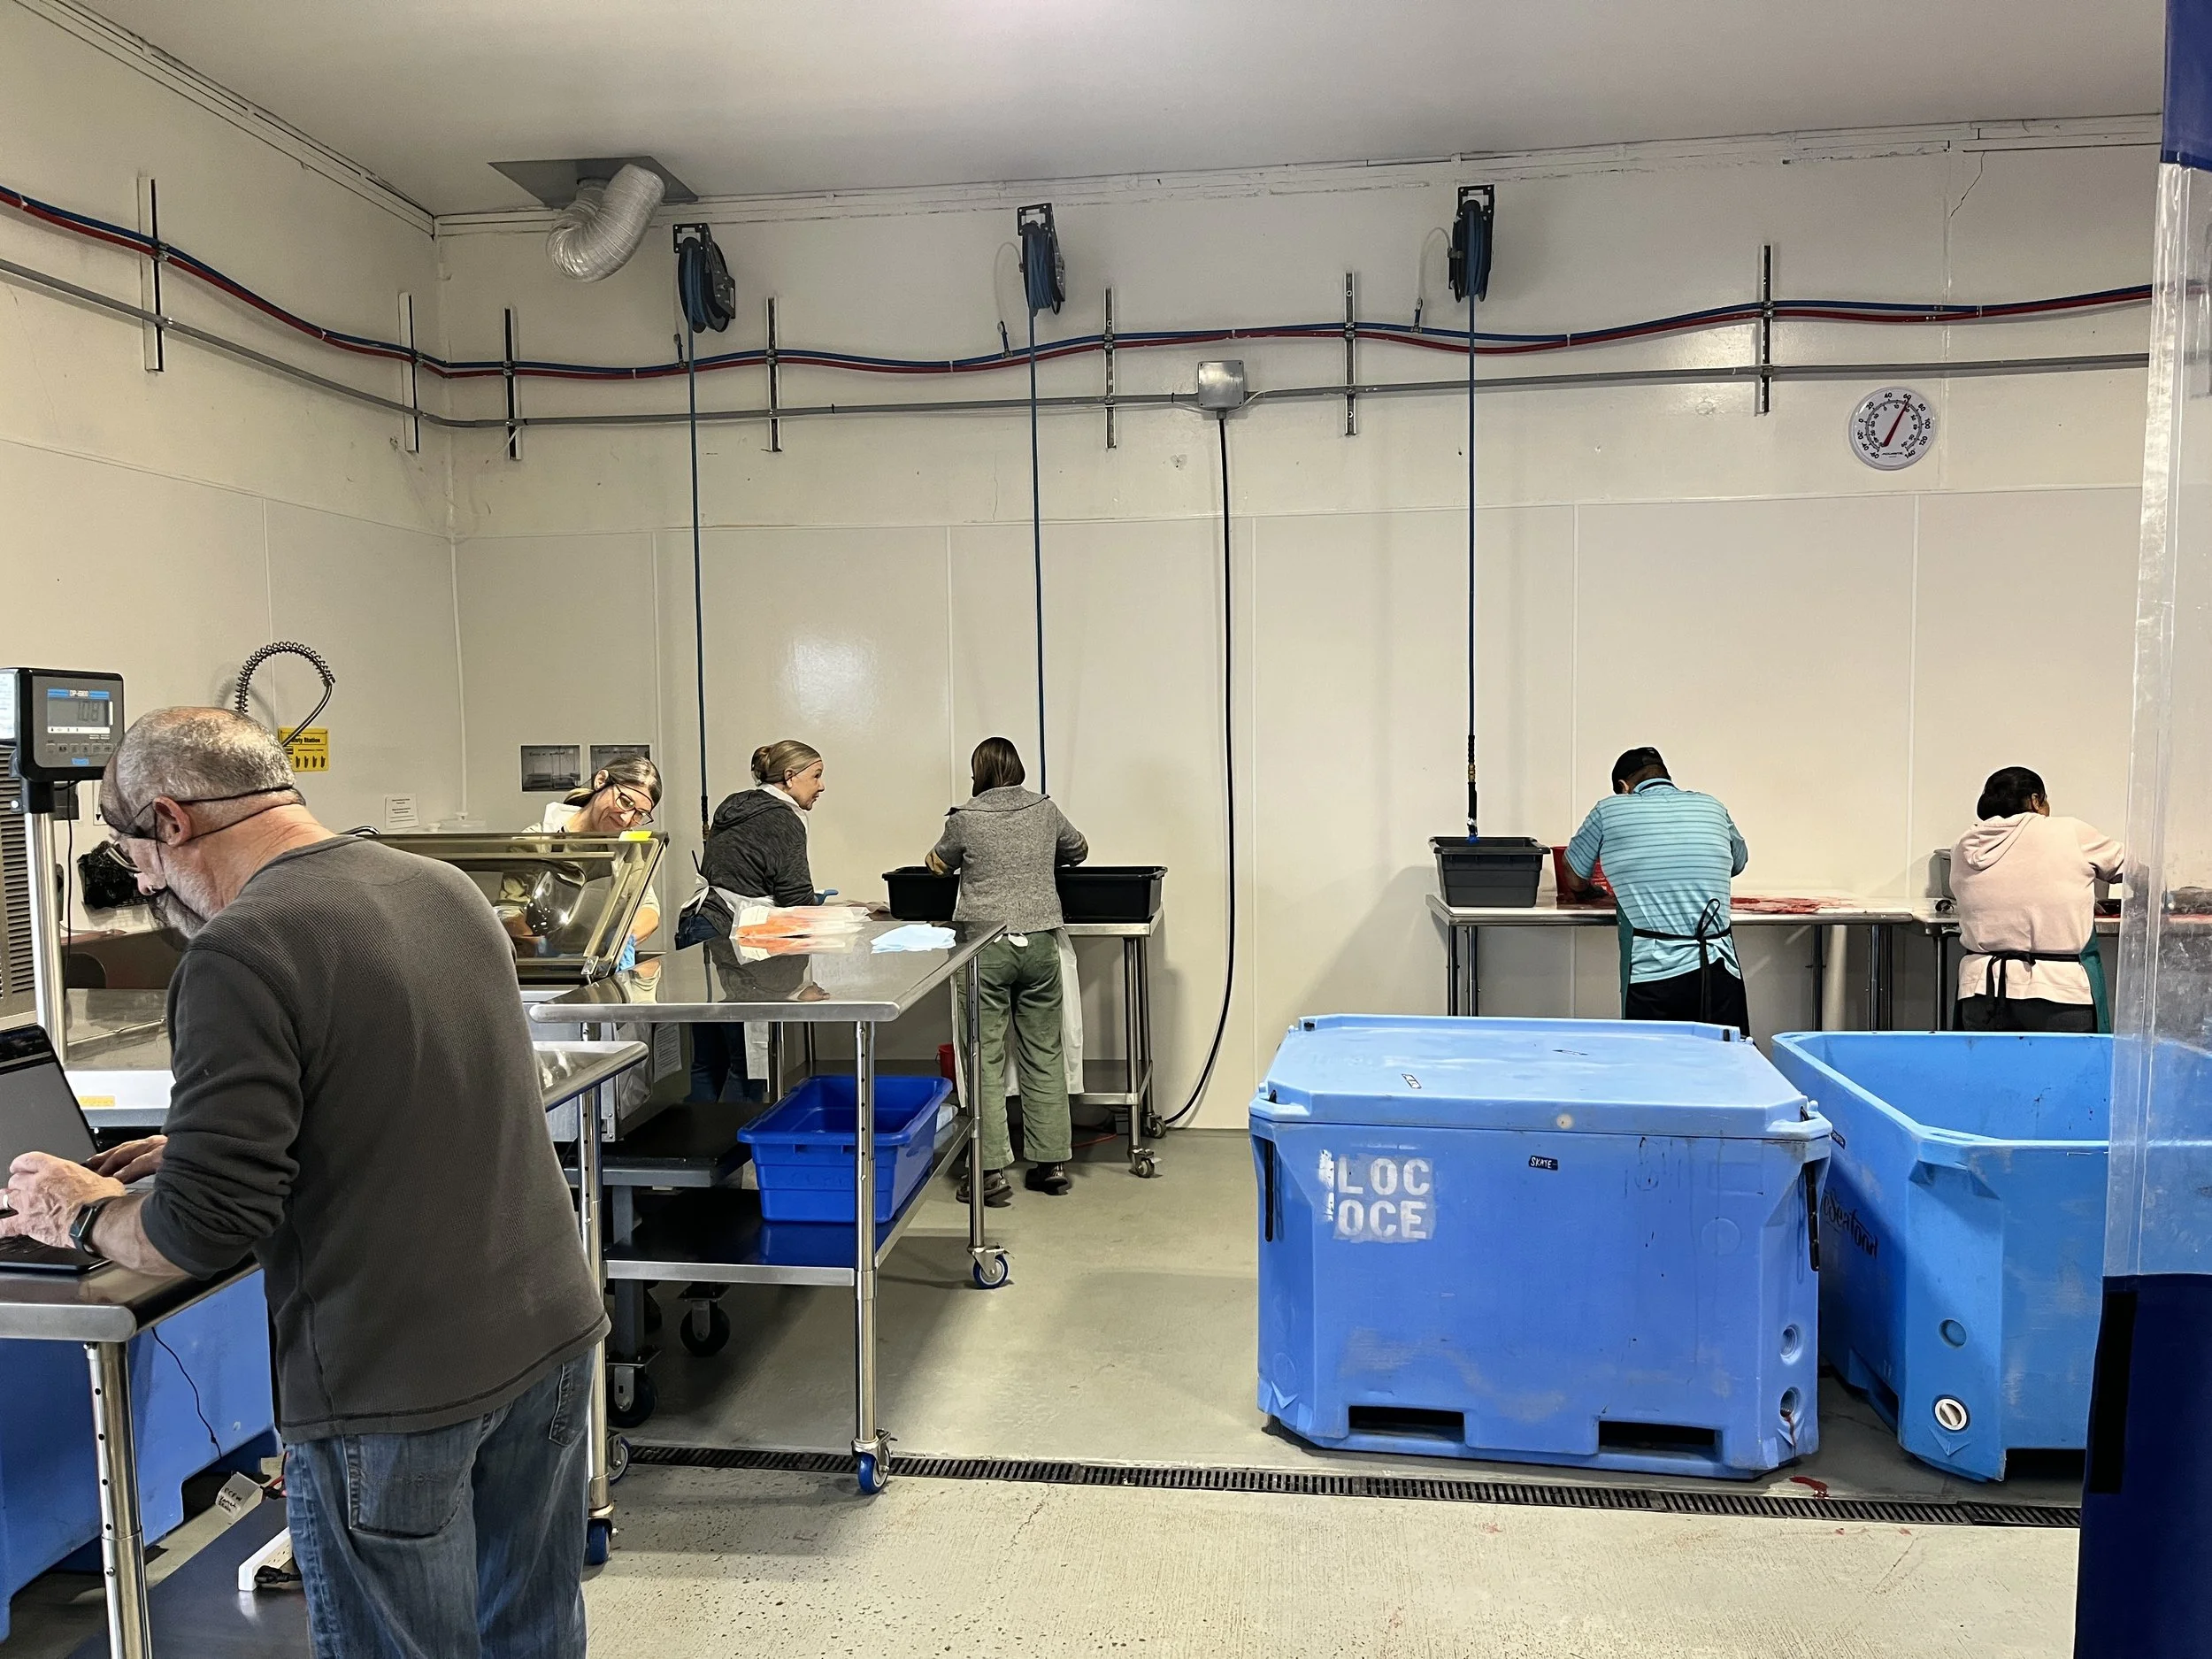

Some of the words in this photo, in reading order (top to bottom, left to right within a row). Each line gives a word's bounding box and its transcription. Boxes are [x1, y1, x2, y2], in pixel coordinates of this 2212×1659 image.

[1866, 401, 1874, 410] 20
[1919, 435, 1928, 446] 120
[1530, 1156, 1553, 1169] SKATE
[1337, 1156, 1431, 1195] LOC
[1337, 1199, 1427, 1240] OCE
